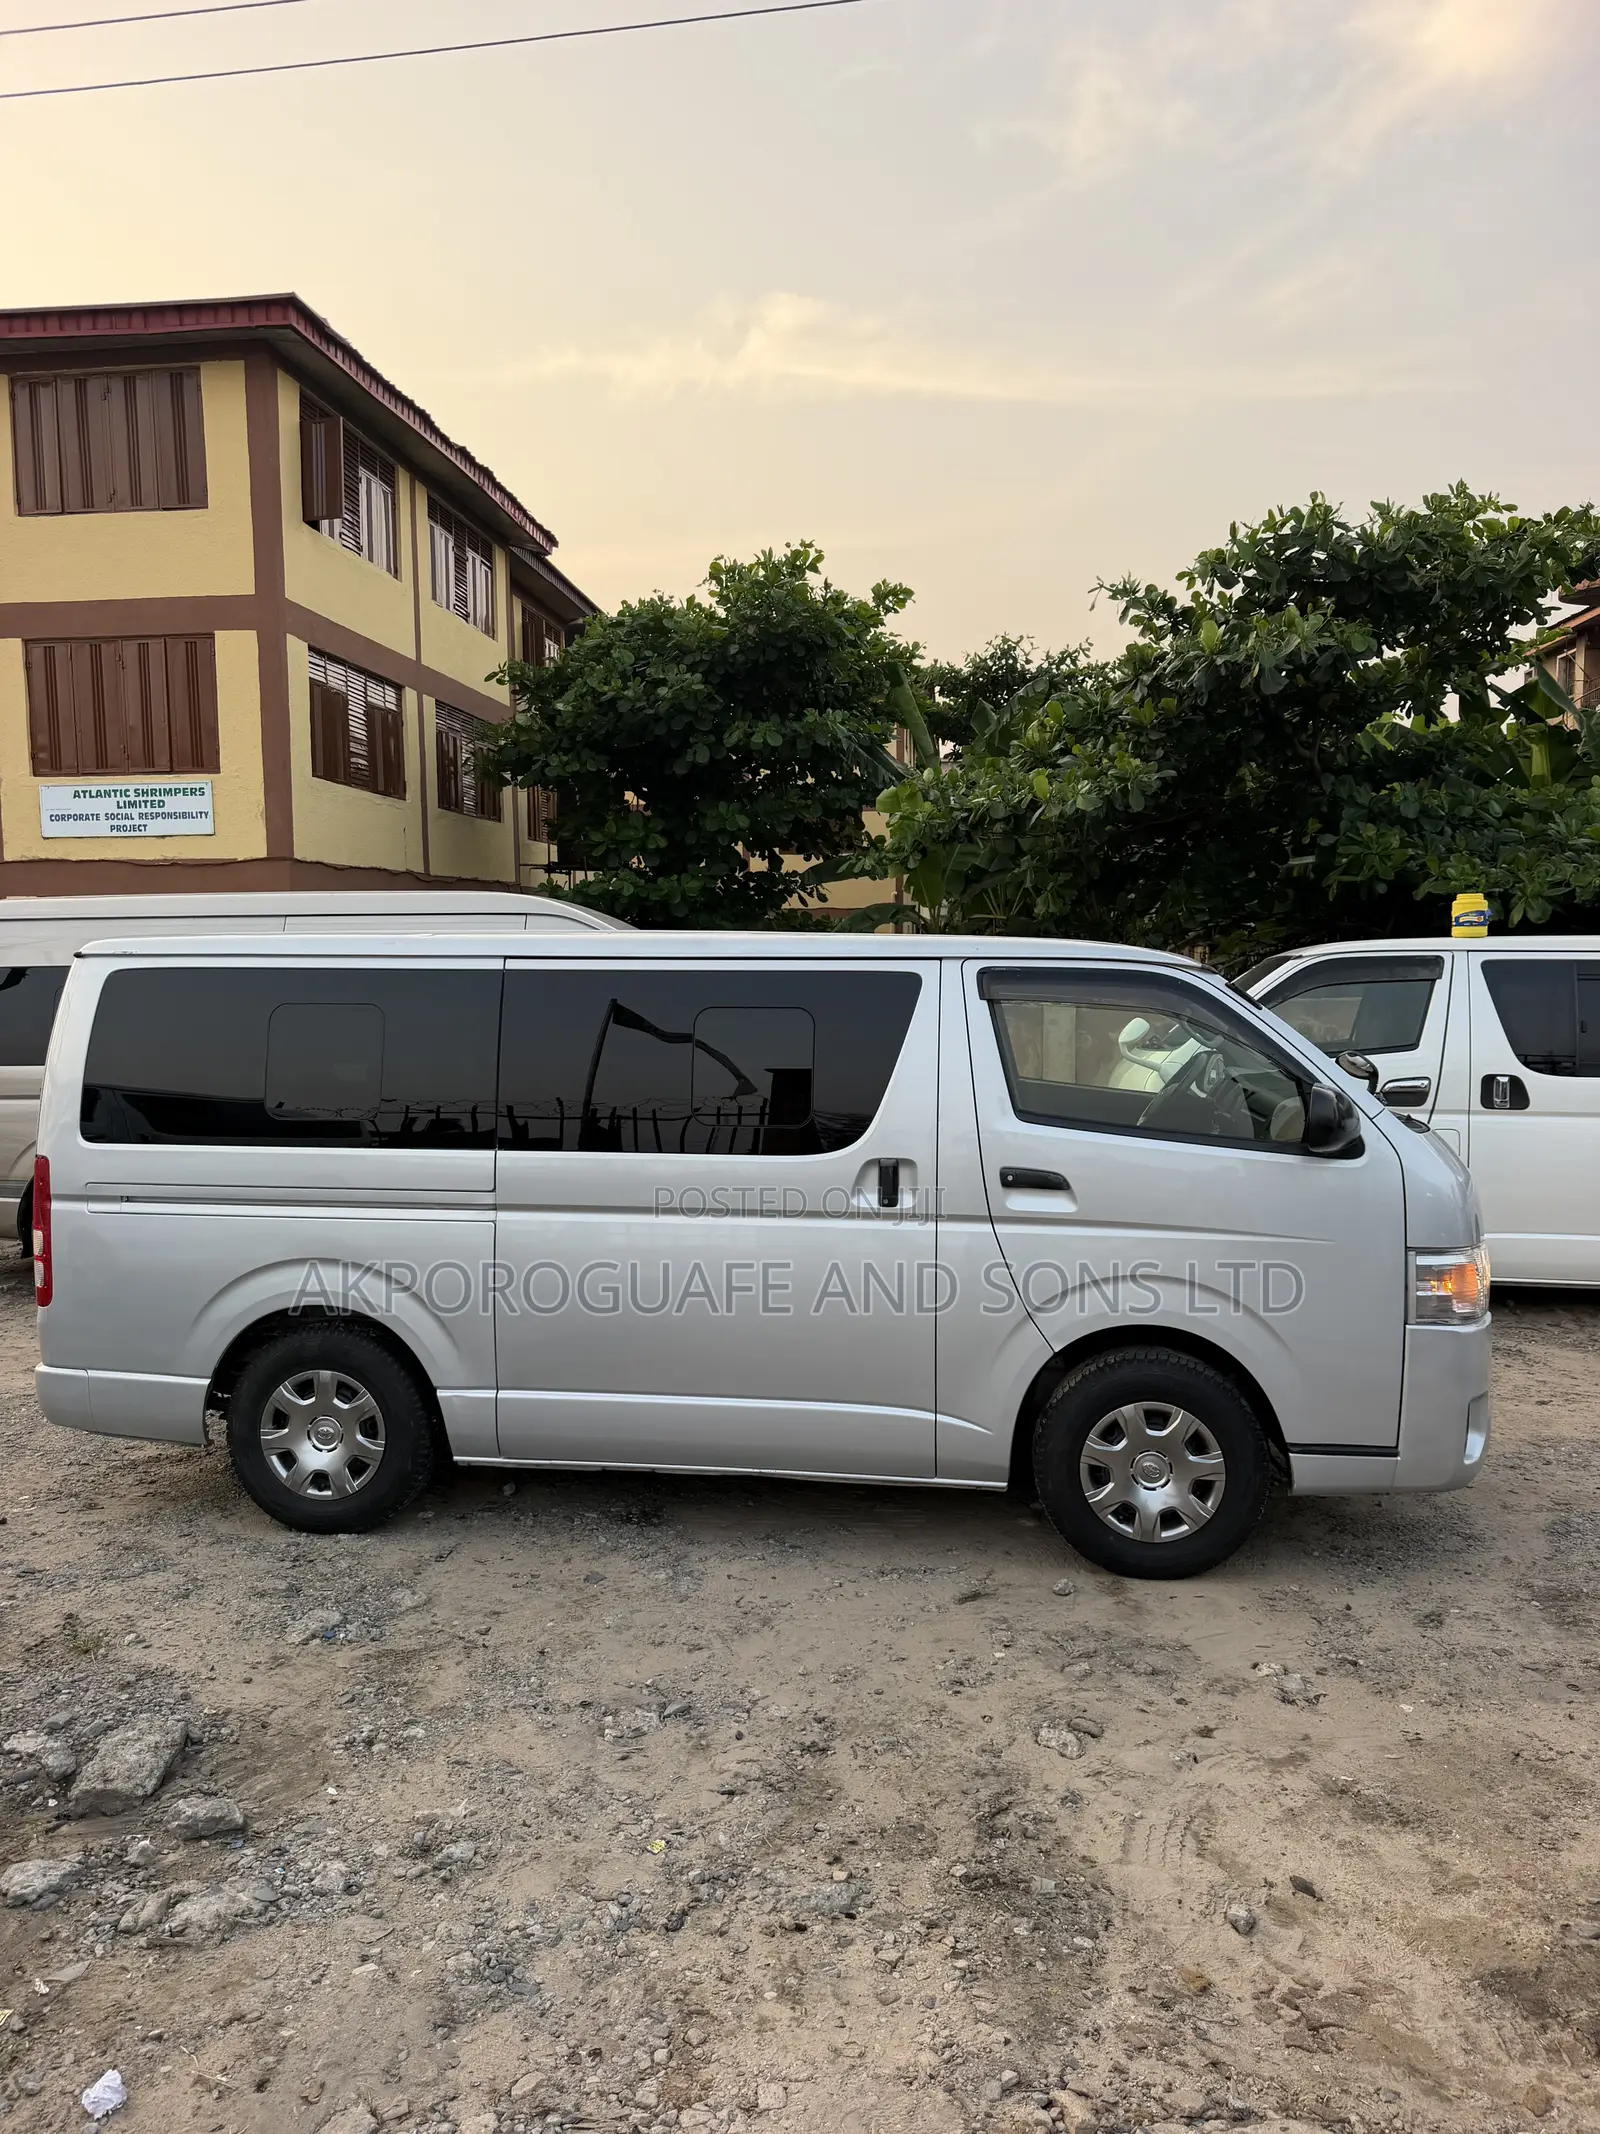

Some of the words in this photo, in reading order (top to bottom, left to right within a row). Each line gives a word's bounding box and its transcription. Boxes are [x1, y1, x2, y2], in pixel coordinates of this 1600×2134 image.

[73, 788, 131, 799] ATLANTIC
[133, 787, 206, 798] SHRIMPERS
[116, 799, 166, 810] LIMITED
[49, 813, 101, 822] CORPORATE
[104, 812, 135, 821] SOCIAL
[138, 811, 209, 821] RESPONSIBILITY
[110, 824, 148, 833] PROJECT
